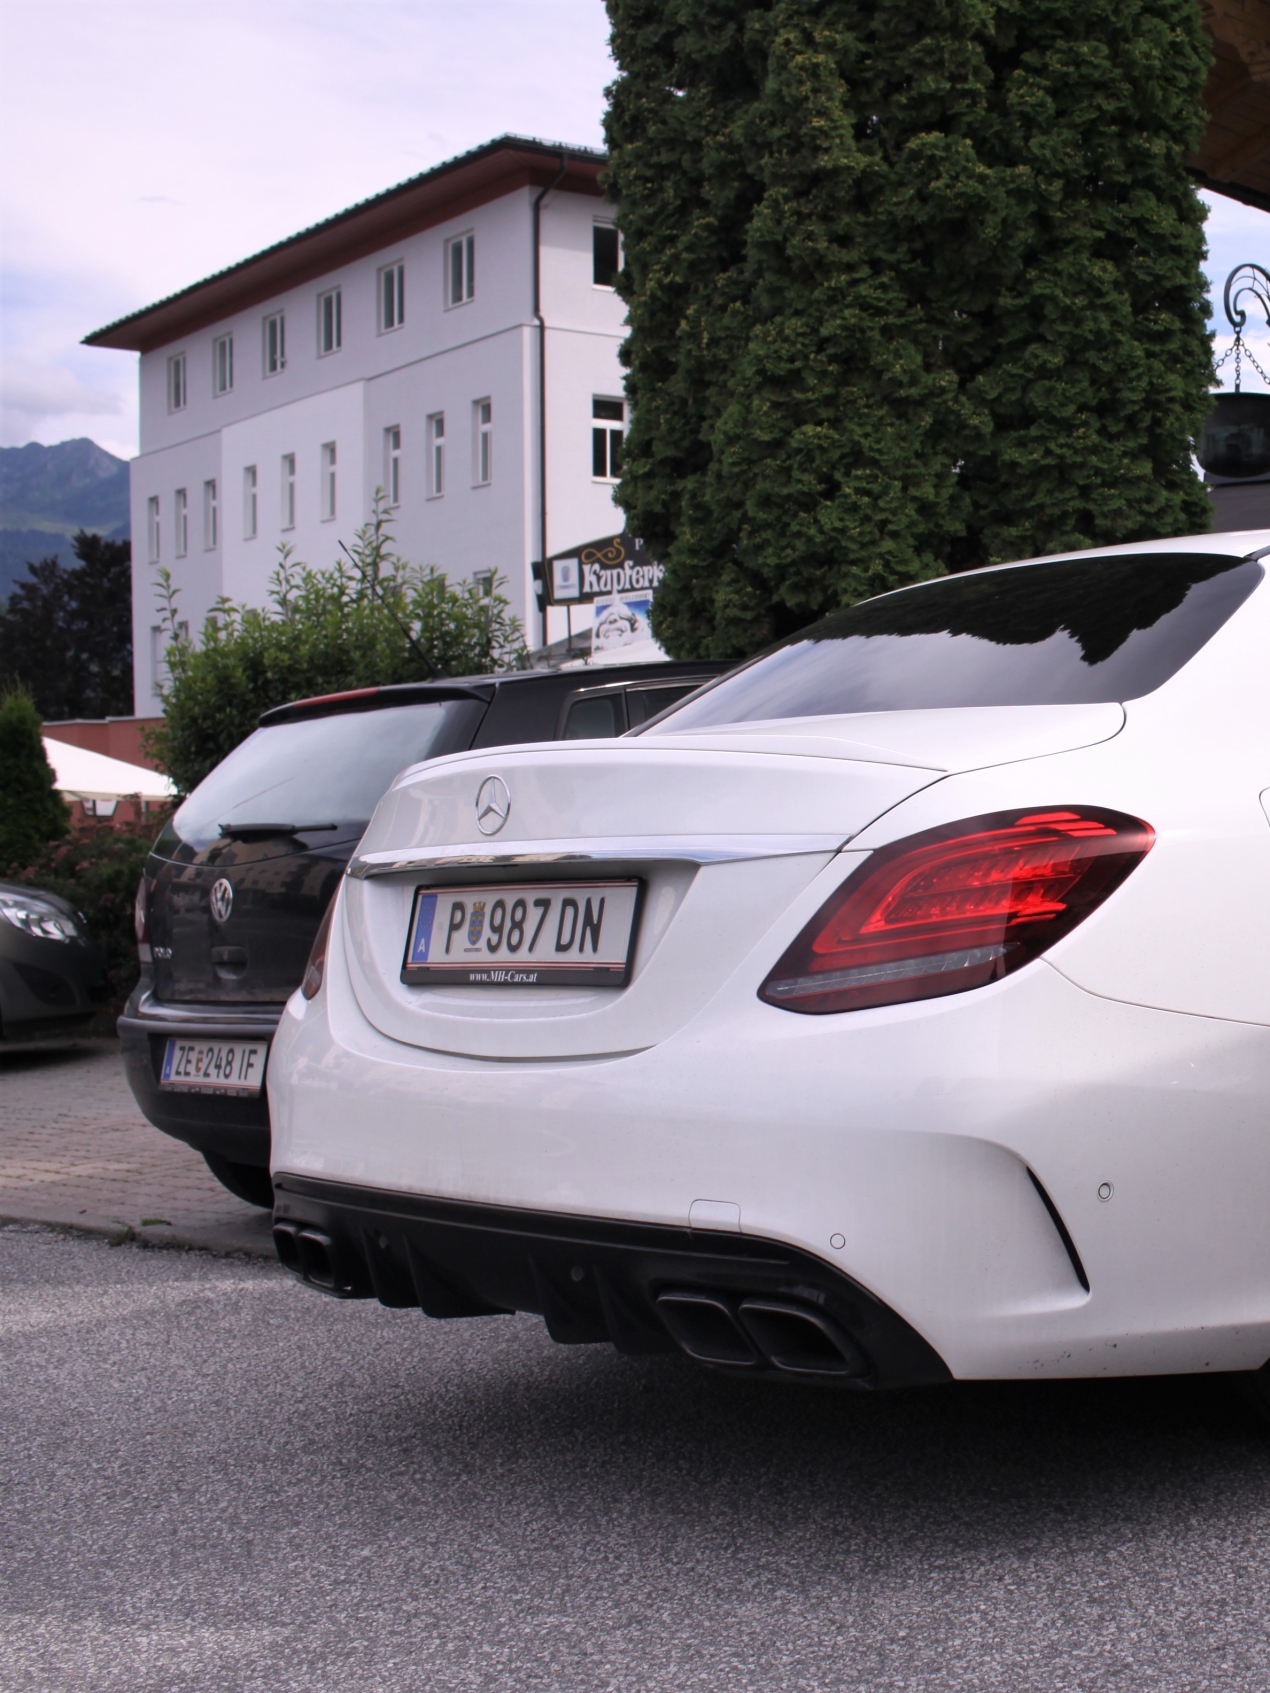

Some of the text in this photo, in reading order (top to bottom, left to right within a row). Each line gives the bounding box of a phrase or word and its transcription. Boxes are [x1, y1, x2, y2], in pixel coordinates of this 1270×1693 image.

[445, 895, 606, 954] P 987 DN
[417, 938, 426, 954] A
[469, 970, 538, 983] www.MH-Cars.at
[175, 1046, 258, 1081] ZE 248 IF
